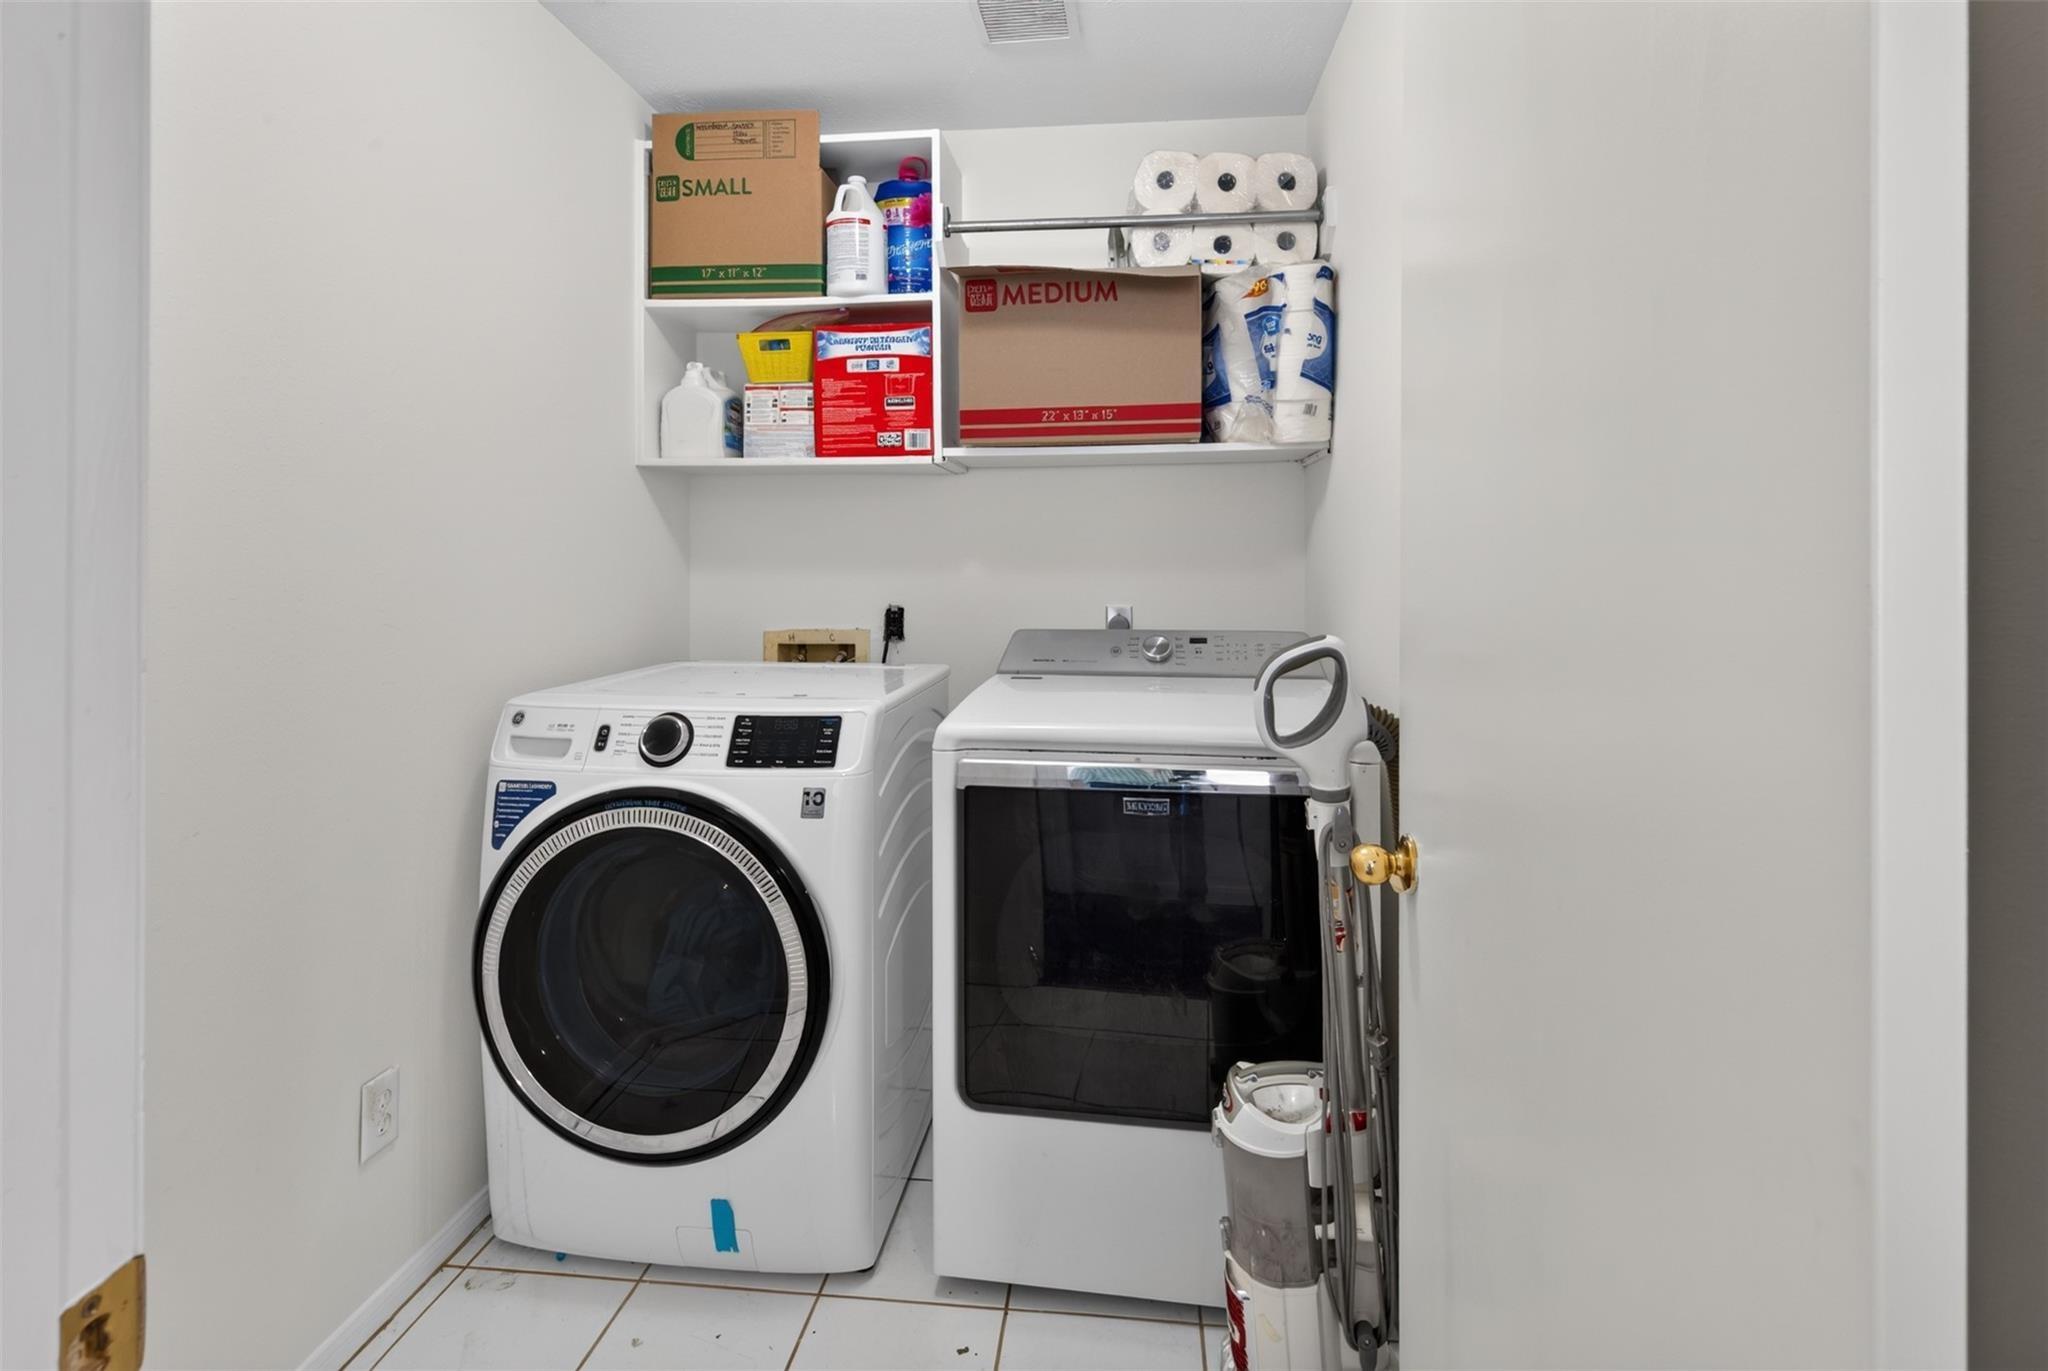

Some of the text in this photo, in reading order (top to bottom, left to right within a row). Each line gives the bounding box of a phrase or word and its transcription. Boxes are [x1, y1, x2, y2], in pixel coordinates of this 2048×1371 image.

[682, 177, 752, 197] SMALL
[719, 270, 725, 279] x
[743, 270, 750, 278] x
[1002, 280, 1118, 306] MEDIUM
[1041, 409, 1060, 422] 22"
[1063, 412, 1070, 421] x
[1091, 412, 1098, 420] x
[1101, 408, 1118, 420] 15"
[803, 791, 825, 806] 10
